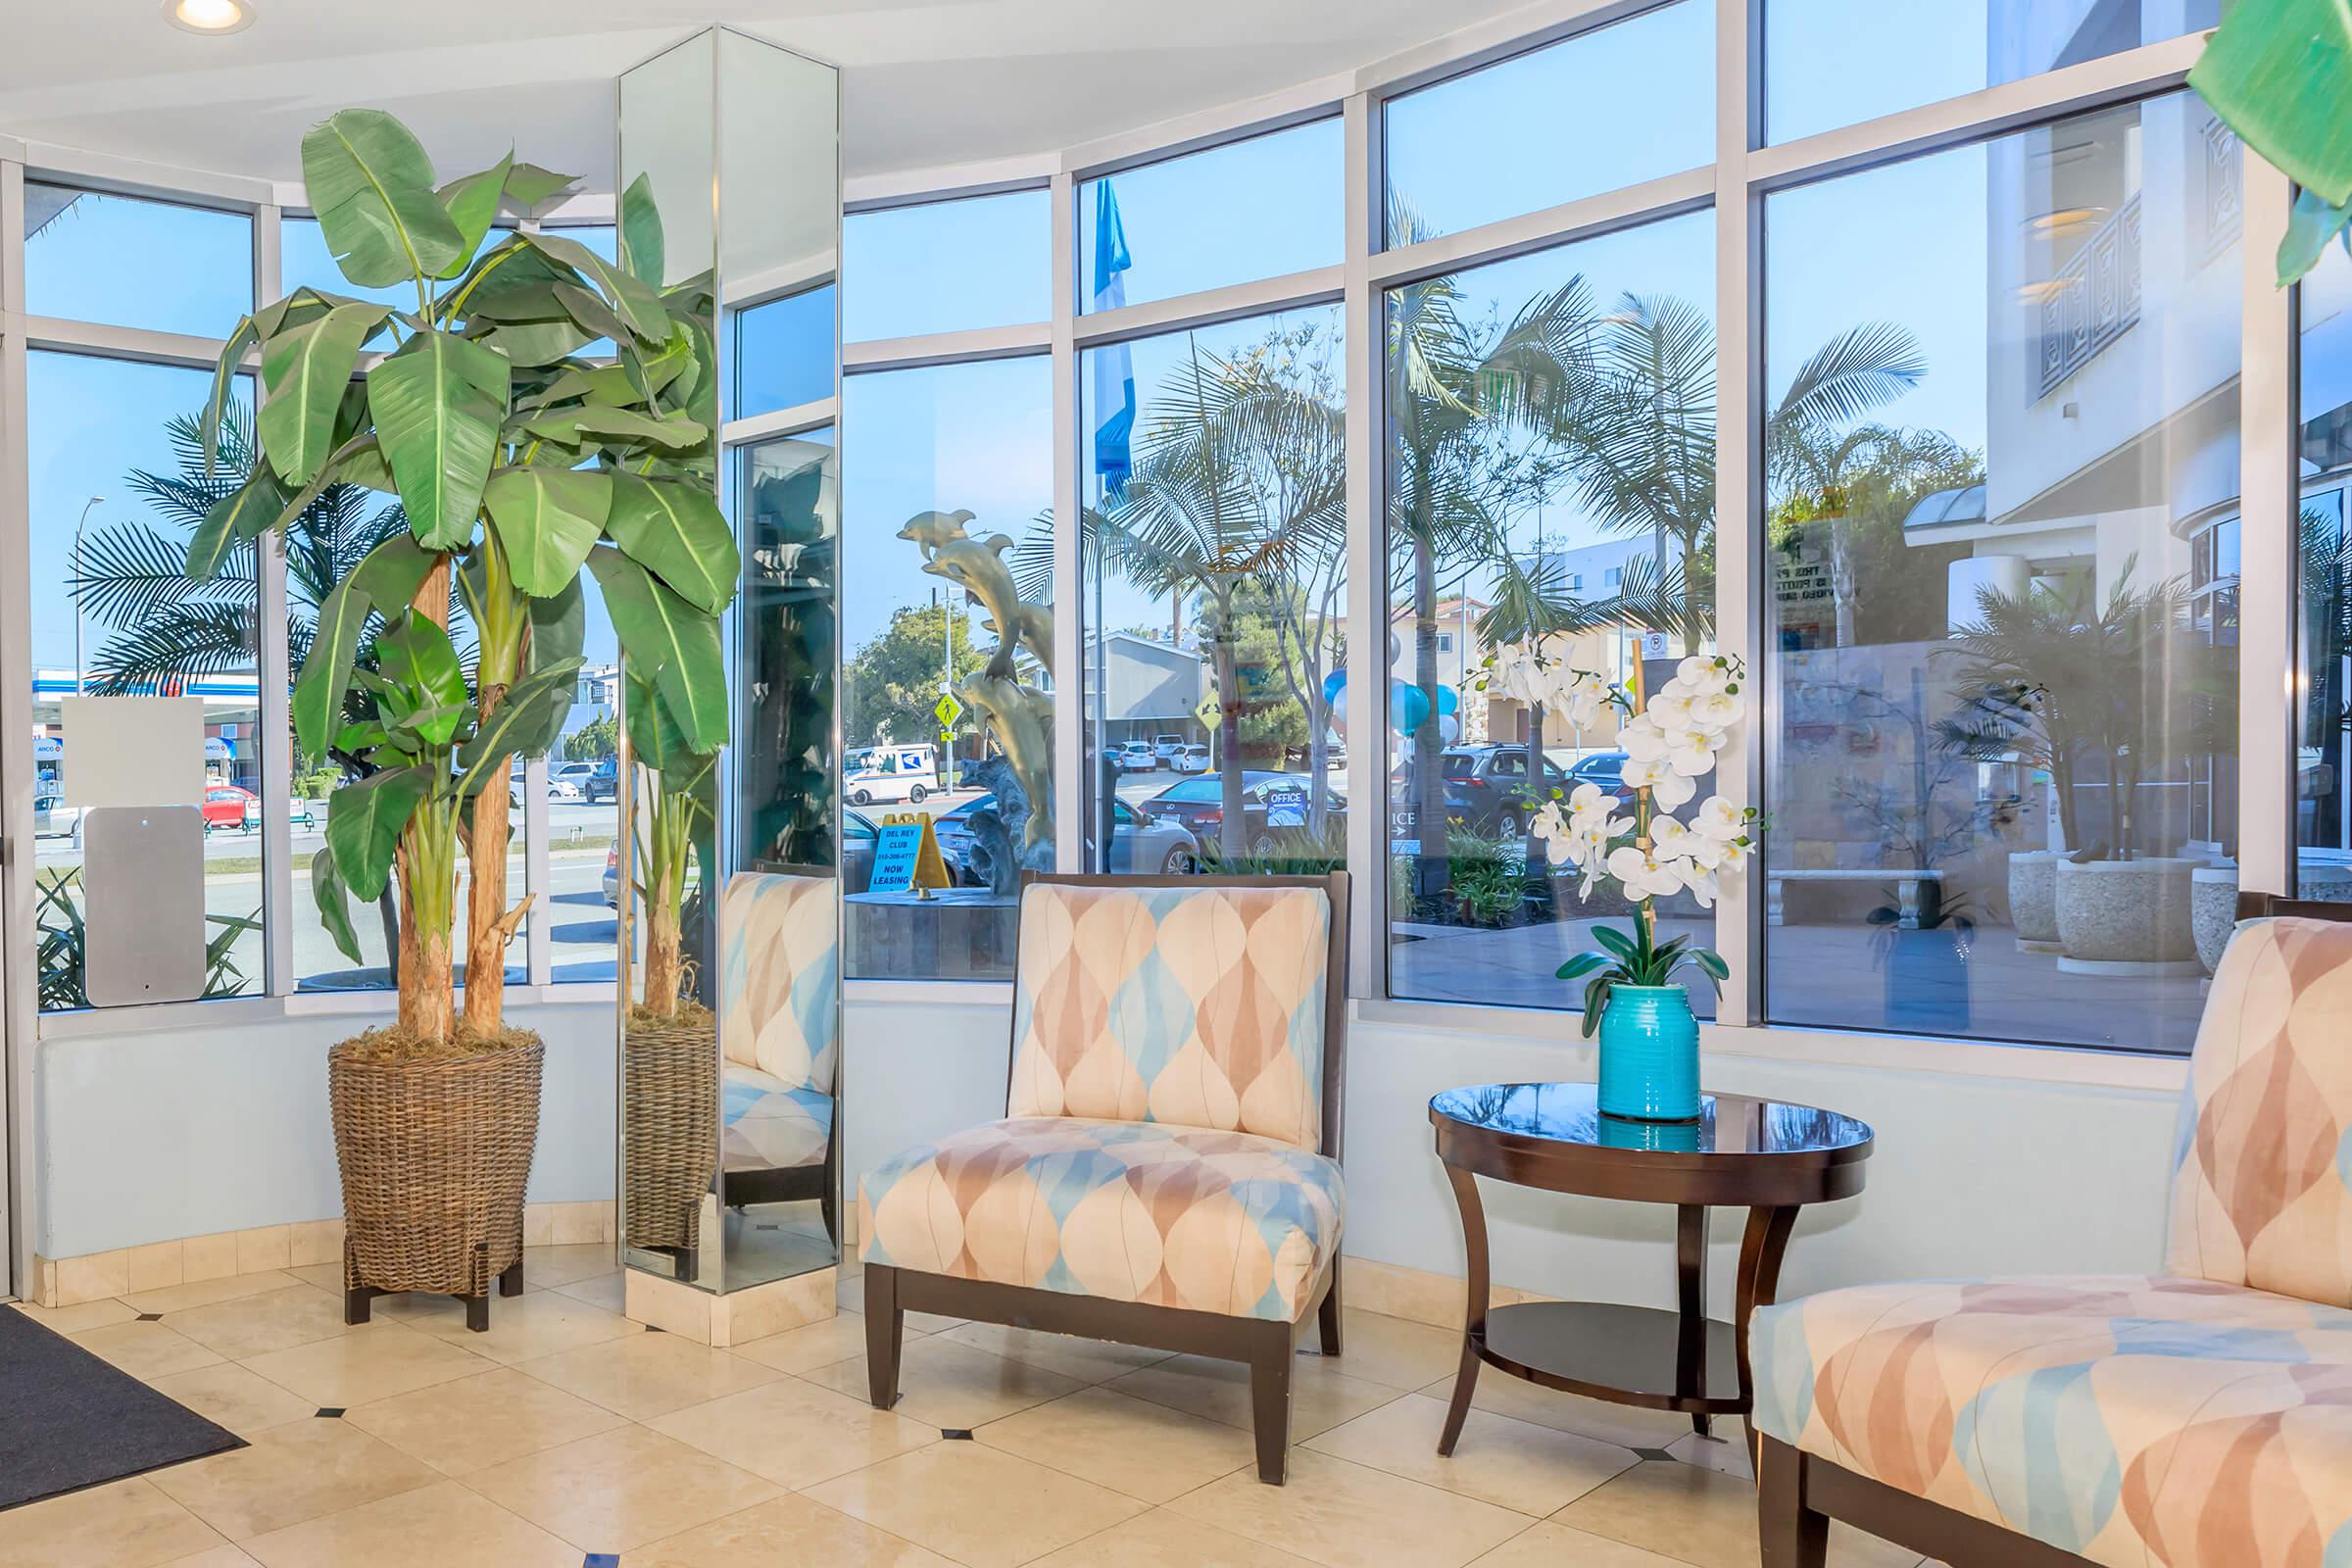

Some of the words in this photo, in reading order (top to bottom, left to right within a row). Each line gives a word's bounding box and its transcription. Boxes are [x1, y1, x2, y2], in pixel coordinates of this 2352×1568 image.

[1270, 793, 1301, 803] OFFICE
[1392, 812, 1416, 825] ICE
[873, 876, 908, 885] LEASING
